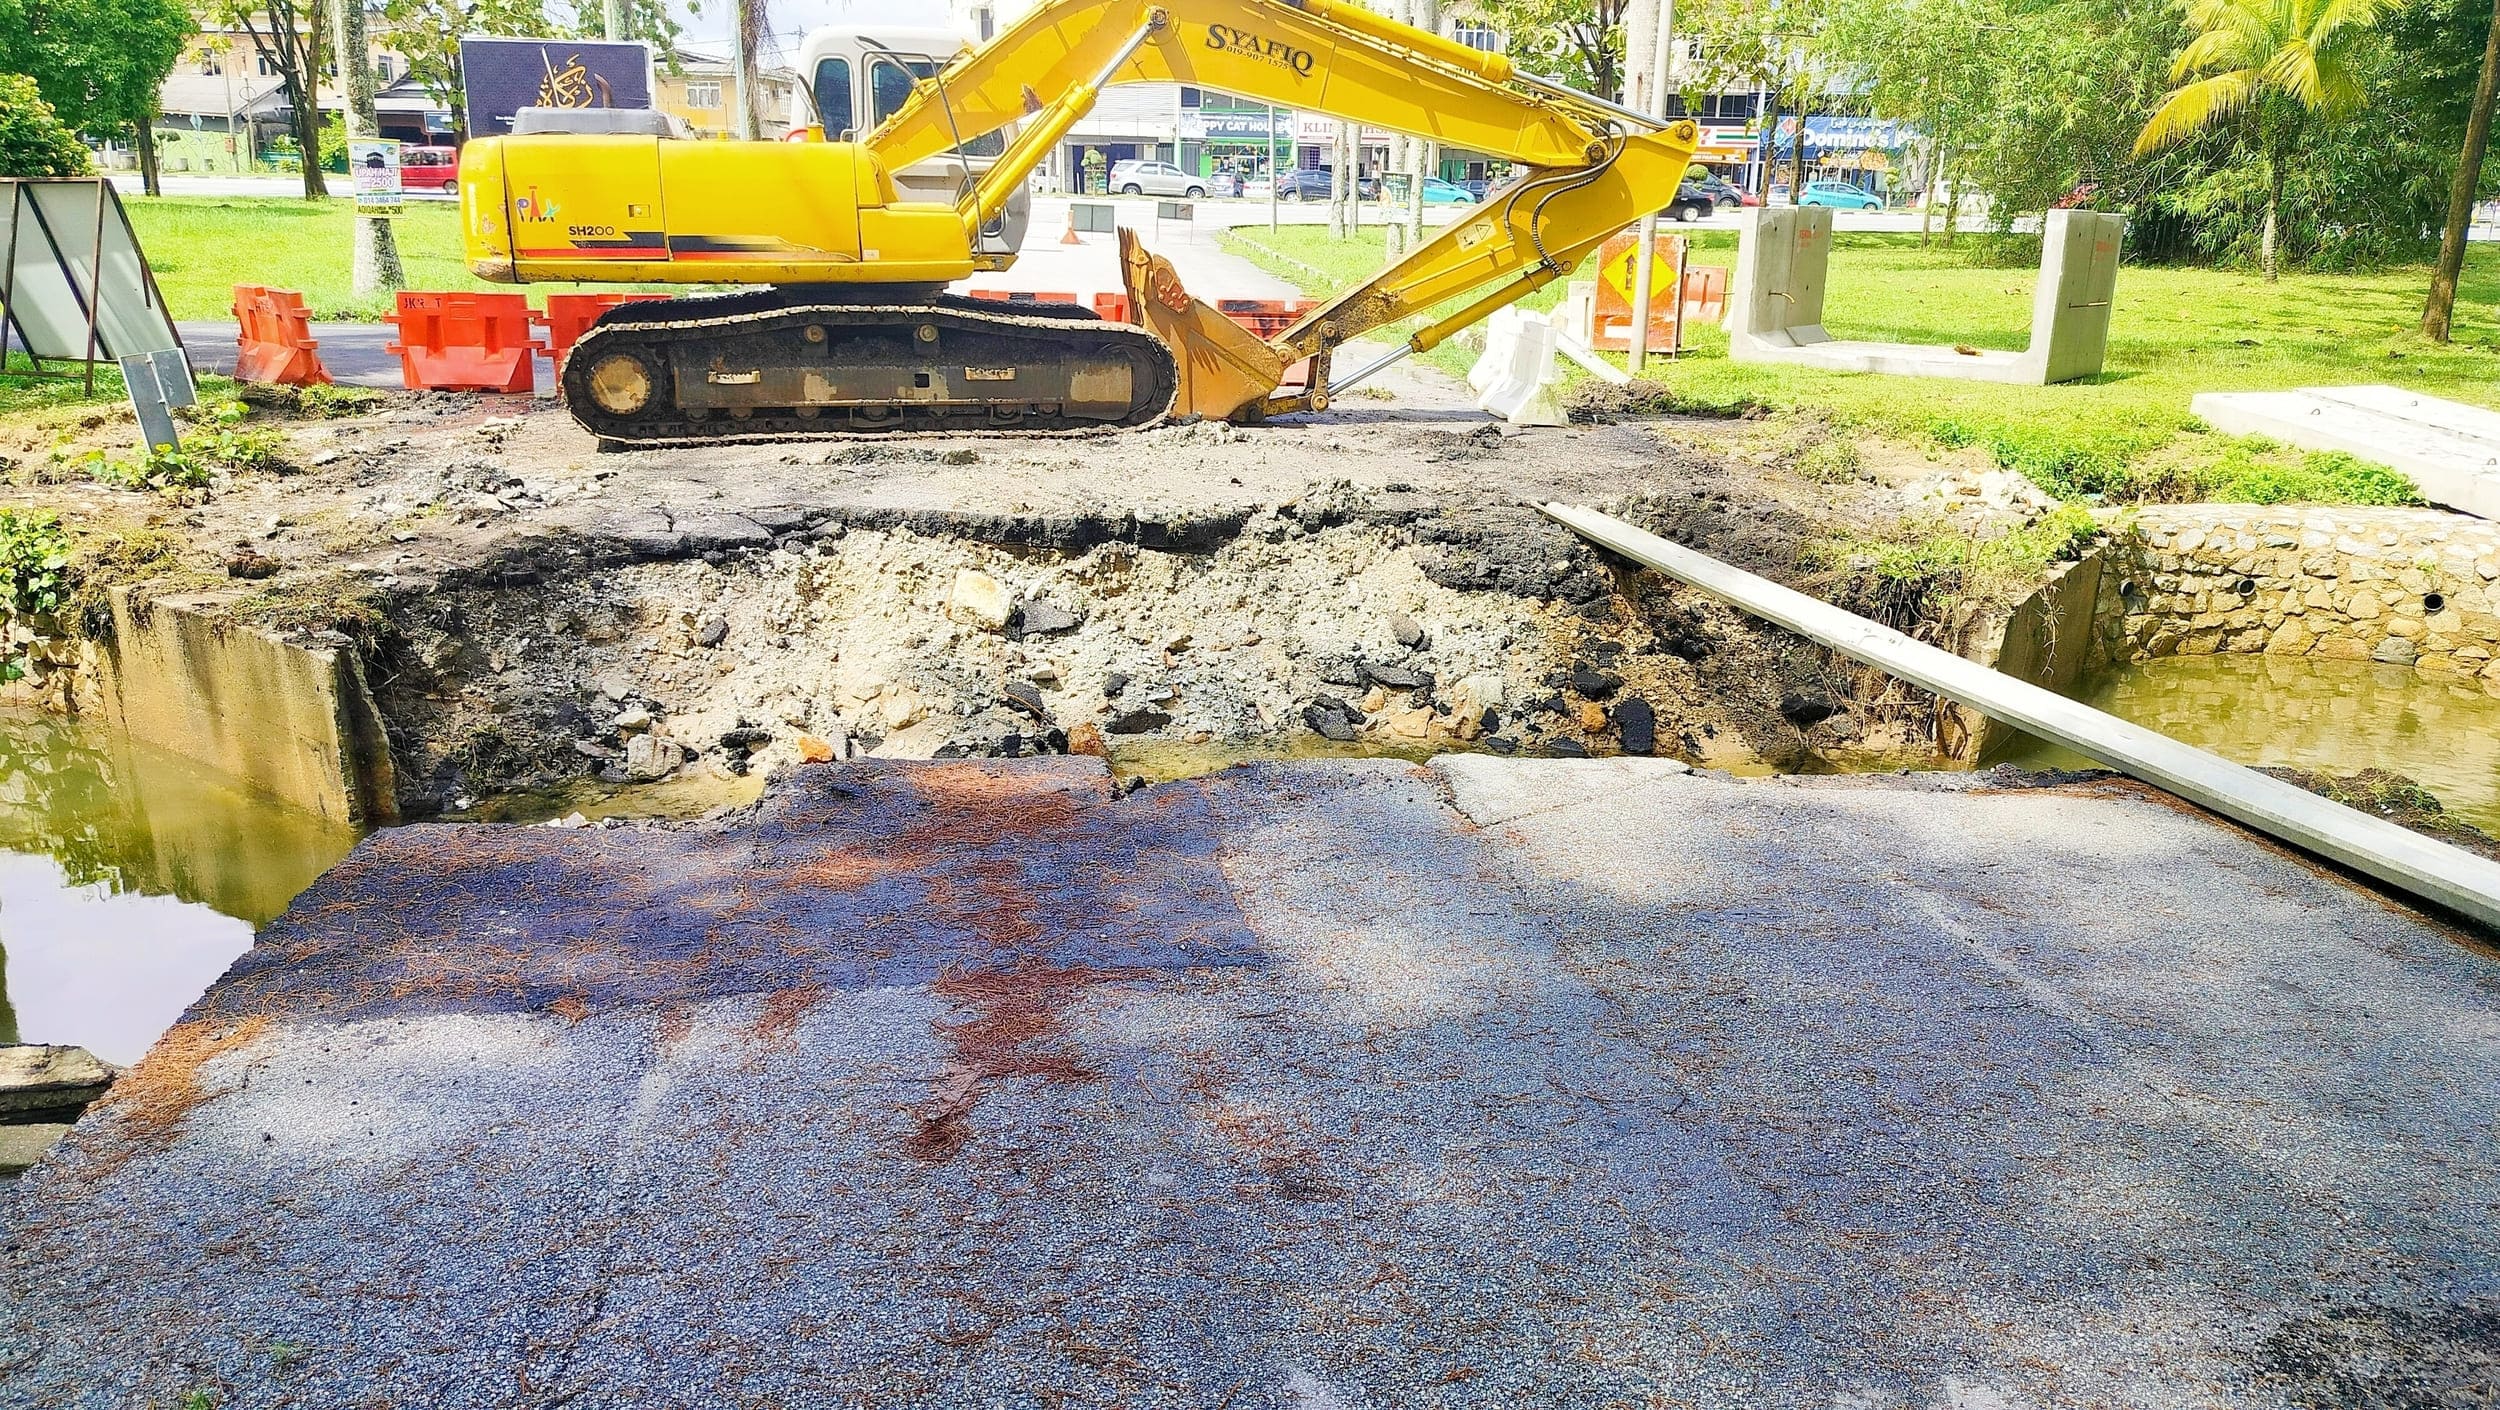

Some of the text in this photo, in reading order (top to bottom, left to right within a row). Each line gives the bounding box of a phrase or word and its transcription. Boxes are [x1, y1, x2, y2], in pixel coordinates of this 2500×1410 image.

[1206, 24, 1314, 78] SYAFIQ
[1226, 46, 1288, 70] 019-907 1575
[1227, 121, 1247, 132] CAT
[1803, 128, 1890, 148] Domino's
[568, 225, 615, 236] SH200
